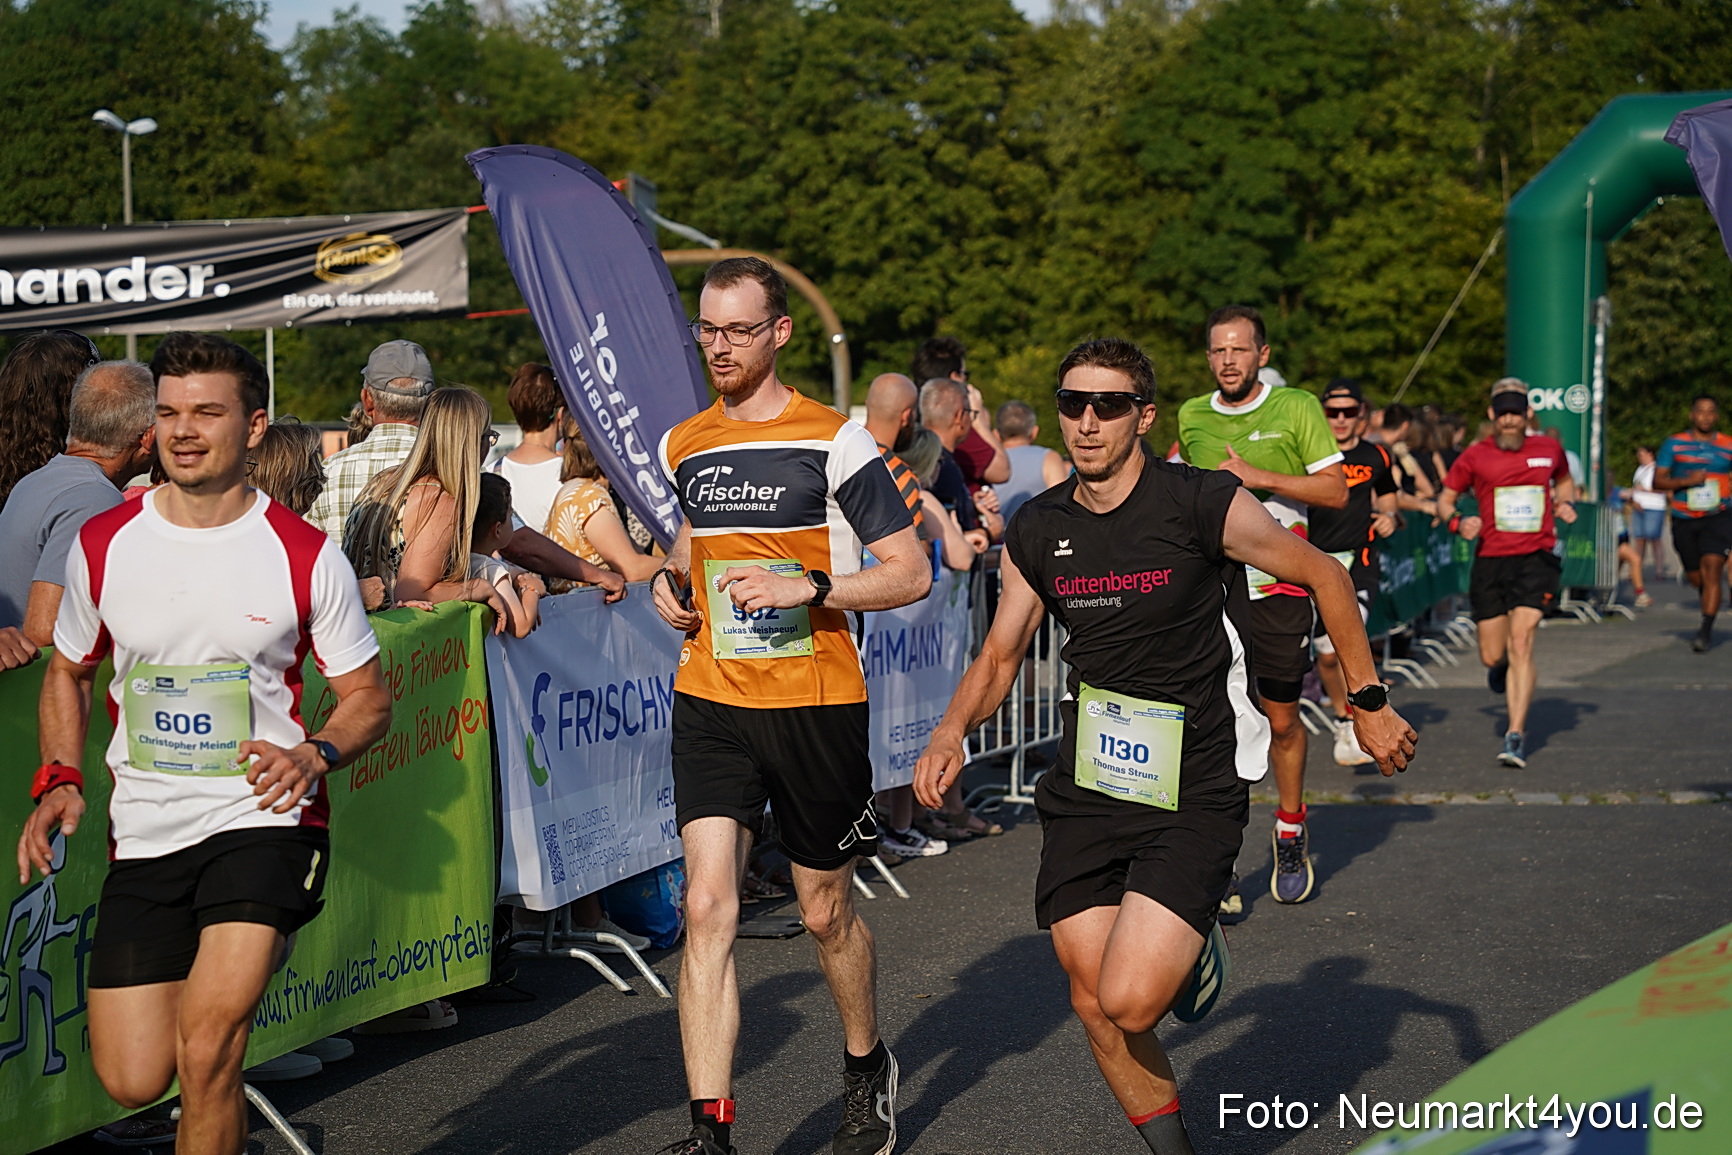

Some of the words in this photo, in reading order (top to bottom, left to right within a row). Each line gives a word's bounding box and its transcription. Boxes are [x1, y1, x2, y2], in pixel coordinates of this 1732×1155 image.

[283, 293, 306, 309] Ein
[336, 292, 363, 307] der
[1527, 387, 1565, 411] OK
[1341, 463, 1373, 479] NGS
[697, 480, 786, 502] Fischer
[703, 502, 778, 513] AUTOMOBILE
[1054, 568, 1173, 596] Guttenberger
[1066, 596, 1122, 609] Lichtwerbung
[722, 626, 748, 635] Lukas
[748, 624, 799, 635] Weishaeupl
[411, 637, 471, 695] Firmen
[155, 710, 212, 735] 606
[558, 672, 675, 751] FRISCHM
[415, 696, 488, 761] länger
[139, 734, 197, 751] Christopher
[200, 740, 237, 750] Meindl
[1099, 733, 1149, 764] 1130
[1092, 756, 1126, 775] Thomas
[1128, 767, 1159, 782] Strunz
[660, 818, 677, 842] MO
[249, 914, 491, 1034] ww.firmenlauf-oberpfalz
